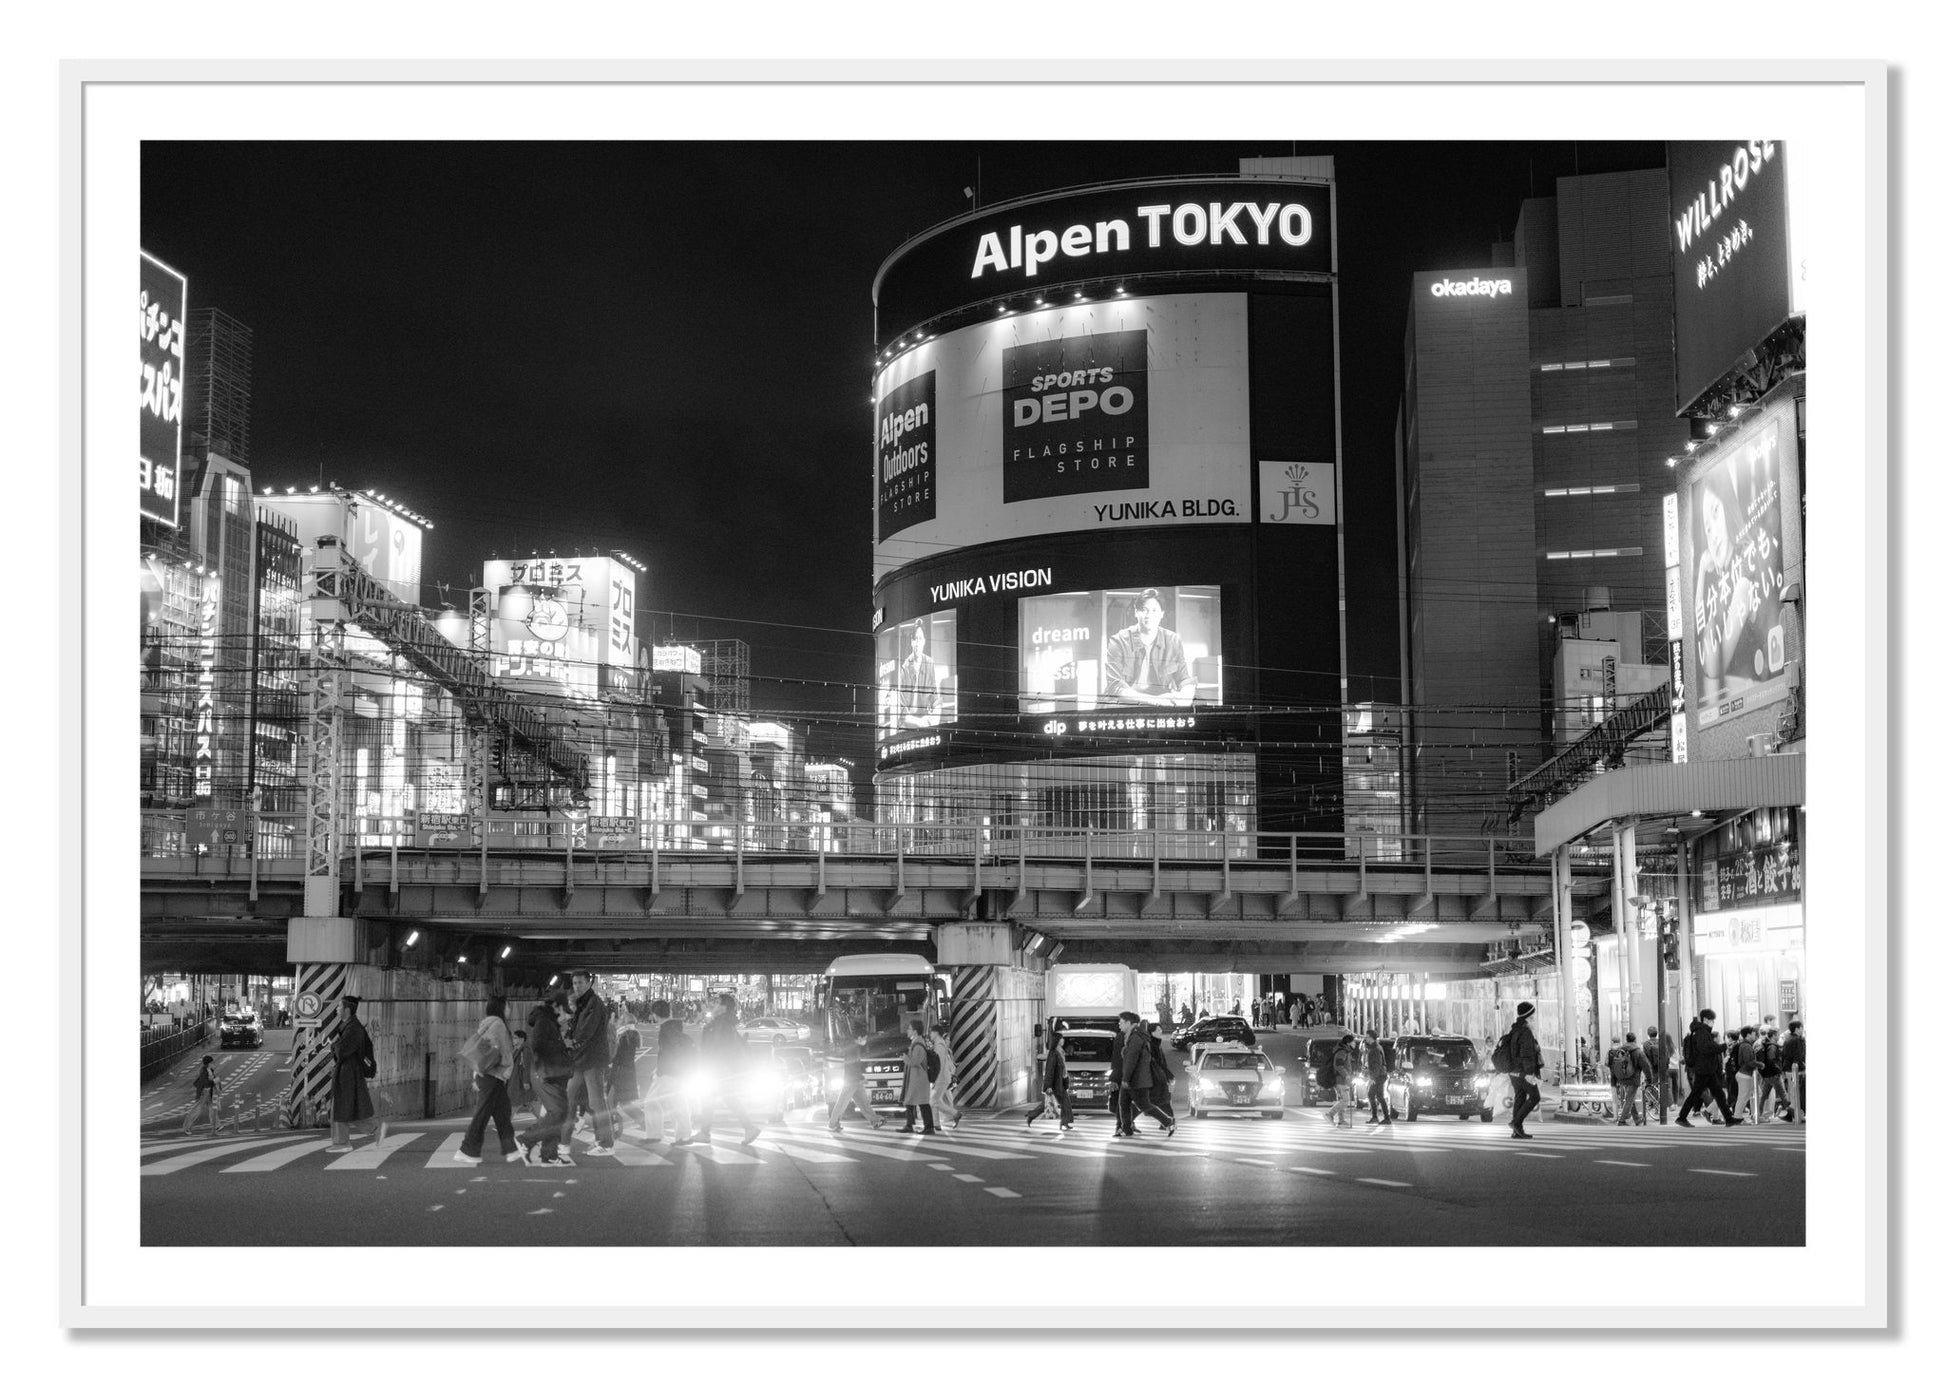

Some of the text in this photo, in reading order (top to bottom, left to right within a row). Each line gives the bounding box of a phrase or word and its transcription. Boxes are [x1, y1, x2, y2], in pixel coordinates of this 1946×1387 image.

[1674, 140, 1775, 253] WILLROSE
[971, 202, 1313, 278] Alpen TOKYO
[1431, 277, 1512, 298] okadaya
[1031, 366, 1114, 393] SPORTS
[1013, 385, 1134, 428] DEPO
[880, 402, 929, 450] Alpen
[1013, 436, 1135, 461] FLAGSHIP
[883, 441, 928, 484] Outdoors
[1057, 455, 1135, 474] STORE
[880, 471, 930, 505] FLAGSHIP
[893, 488, 930, 513] STORE
[1093, 498, 1241, 522] YUNIKA BLDG.
[266, 568, 297, 590] SHISHA
[510, 562, 583, 584] プロミス
[931, 567, 1053, 603] YUNIKA VISION
[1032, 626, 1090, 644] dream
[1044, 716, 1195, 735] dip 夢を叶える仕事に出会おう
[420, 814, 468, 825] 新宿駅東口
